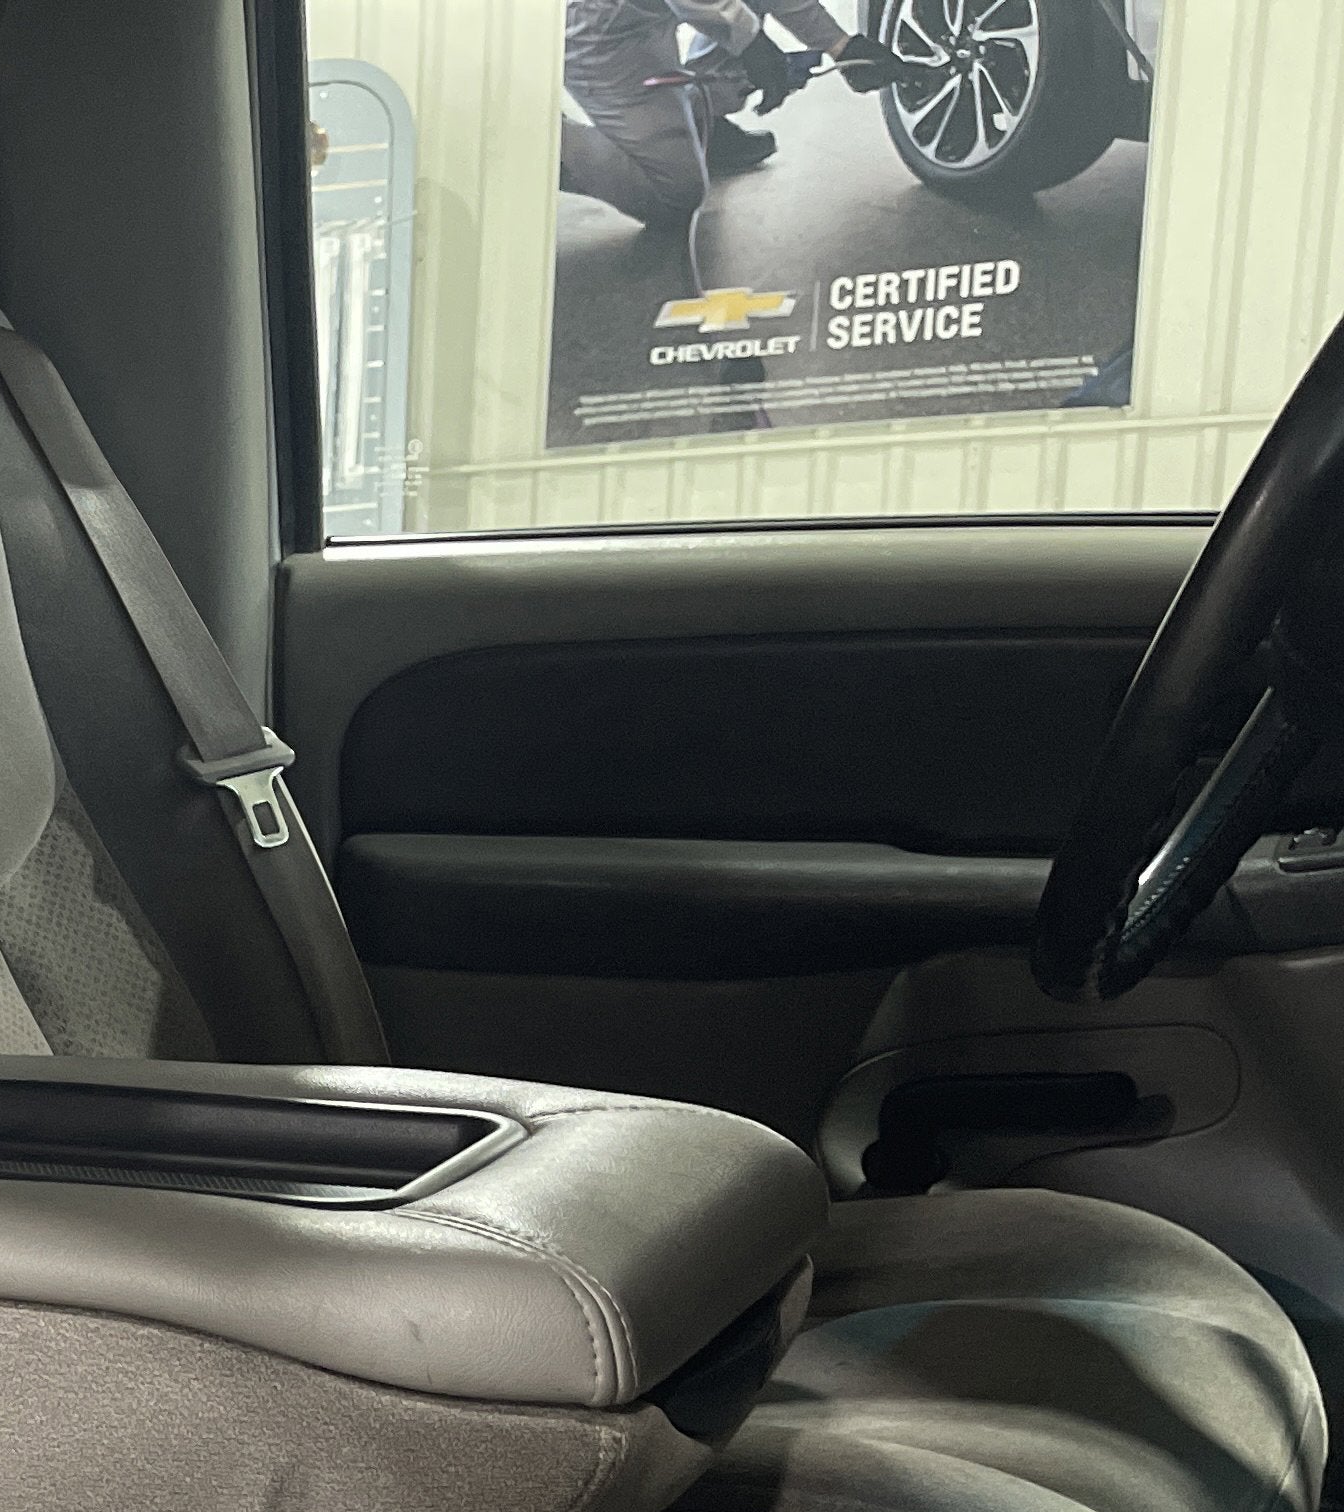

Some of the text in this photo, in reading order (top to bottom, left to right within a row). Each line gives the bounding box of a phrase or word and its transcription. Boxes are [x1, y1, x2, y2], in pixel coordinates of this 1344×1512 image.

[829, 259, 1021, 310] CERTIFIED
[649, 335, 801, 365] CHEVROLET
[826, 302, 985, 350] SERVICE
